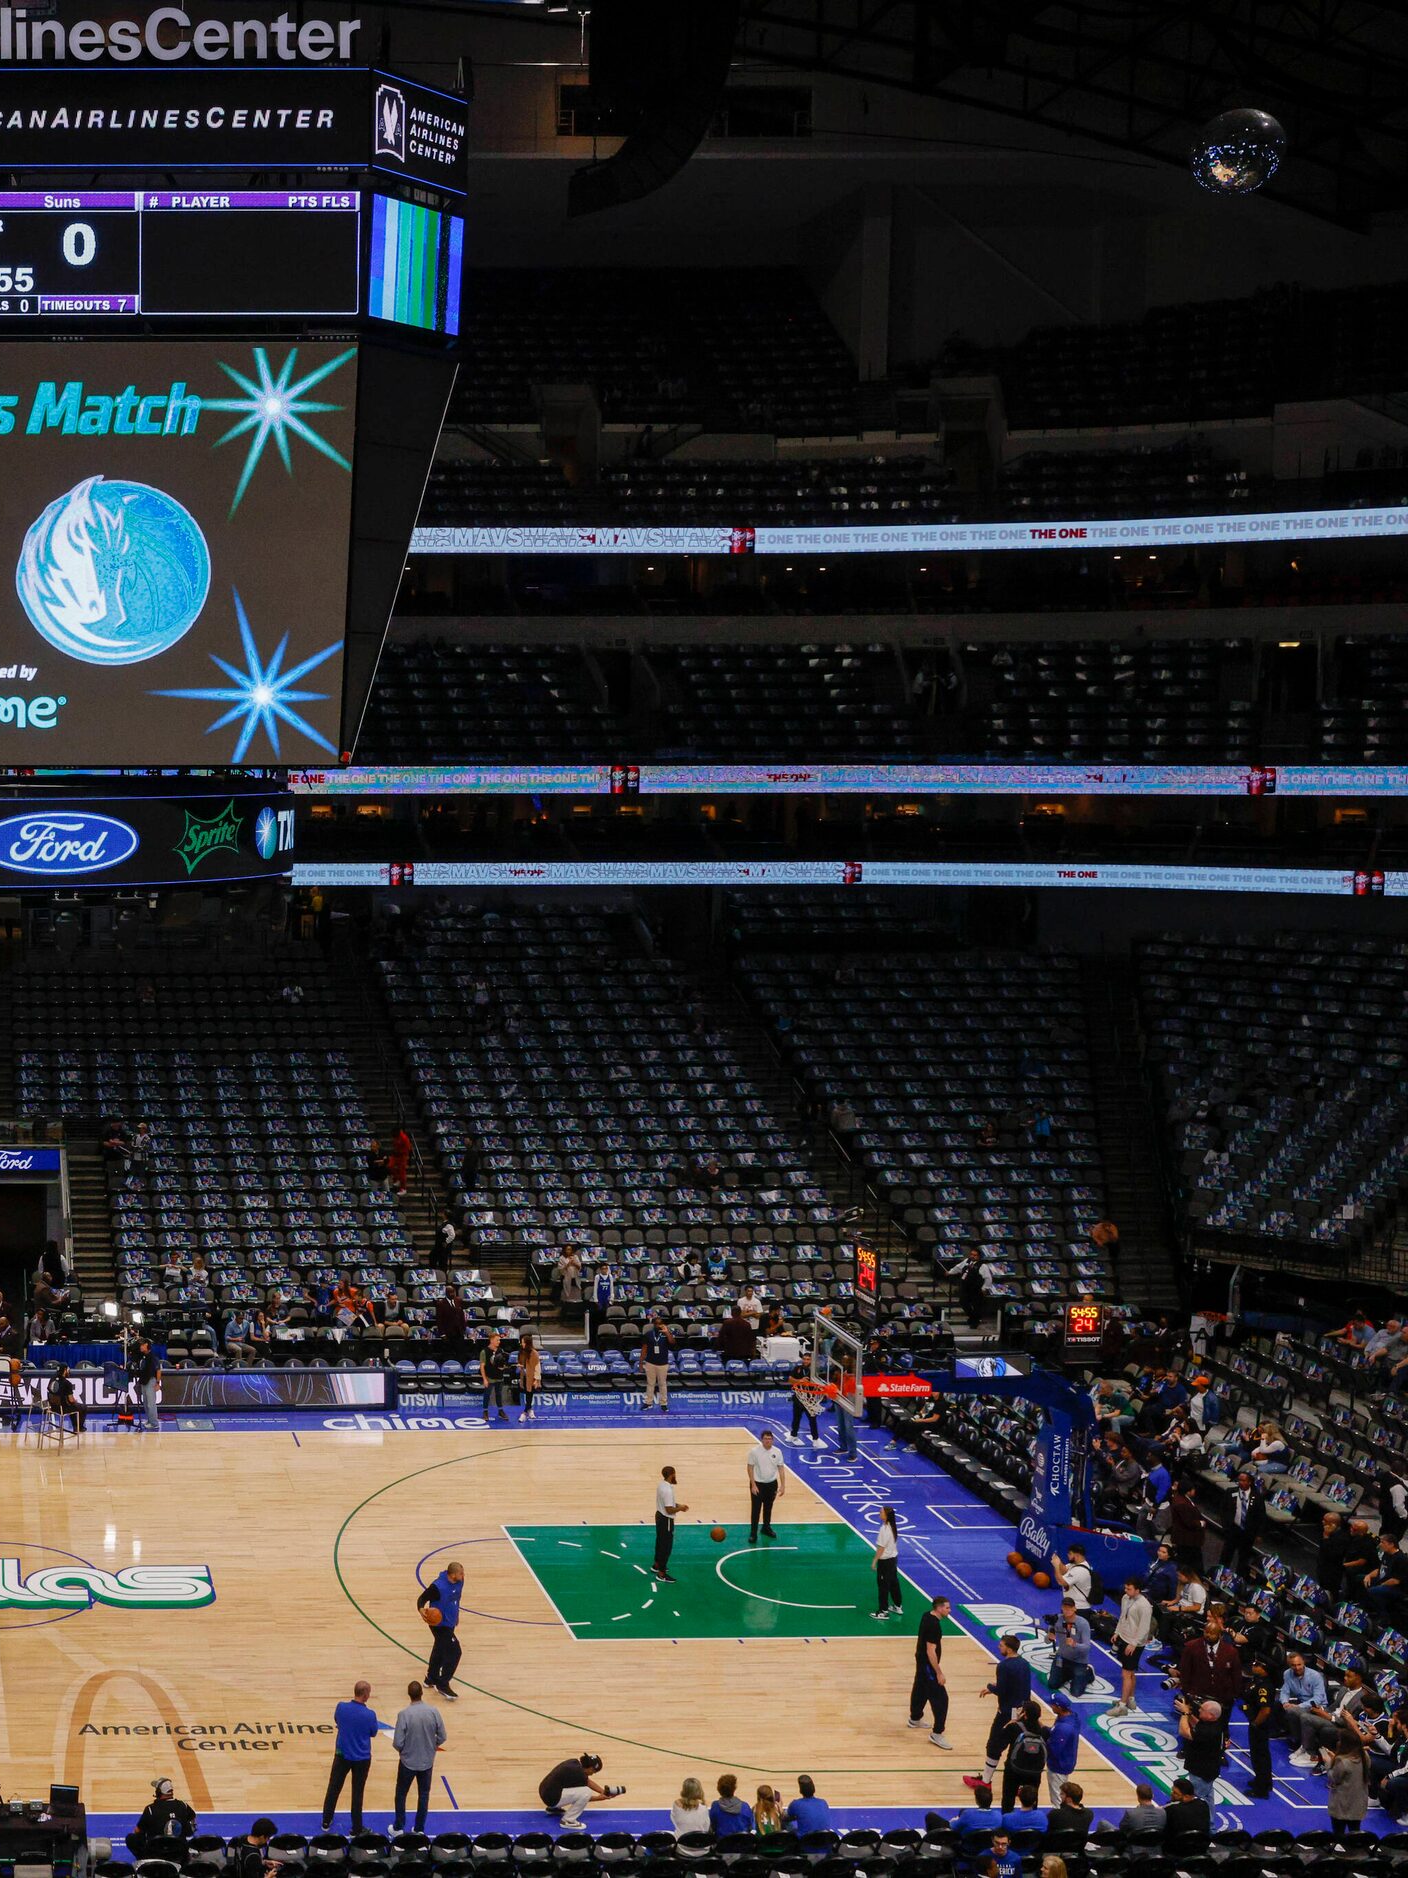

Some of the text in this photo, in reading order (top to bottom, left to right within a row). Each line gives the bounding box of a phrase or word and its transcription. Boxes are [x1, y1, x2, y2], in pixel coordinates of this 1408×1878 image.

[409, 107, 465, 137] AMERICAN
[409, 123, 459, 151] AIRLINES
[43, 195, 81, 209] Suns
[171, 196, 231, 208] PLAYER
[288, 196, 318, 208] PTS
[322, 196, 350, 208] FLS
[62, 222, 96, 267] 0
[19, 299, 29, 314] 0
[42, 299, 127, 313] TIMEOUTS 7
[35, 380, 202, 437] Match
[881, 515, 1382, 543] ONE THE ONE THE ONE THE ONE THE ONE THE ONE THE ONE THE ONE THE
[15, 665, 38, 683] by
[9, 820, 110, 862] Ford
[184, 822, 235, 852] Sprite
[1057, 870, 1098, 879] THE ONE
[858, 1263, 876, 1292] 24
[1071, 1307, 1098, 1319] 54:55
[1075, 1319, 1093, 1332] 24
[400, 1394, 438, 1406] UTSW
[722, 1391, 765, 1404] UTSW
[323, 1413, 490, 1431] chime
[1020, 1516, 1051, 1556] Bally
[1025, 1539, 1042, 1559] SPORTS
[78, 1721, 229, 1735] American
[177, 1737, 284, 1752] Center
